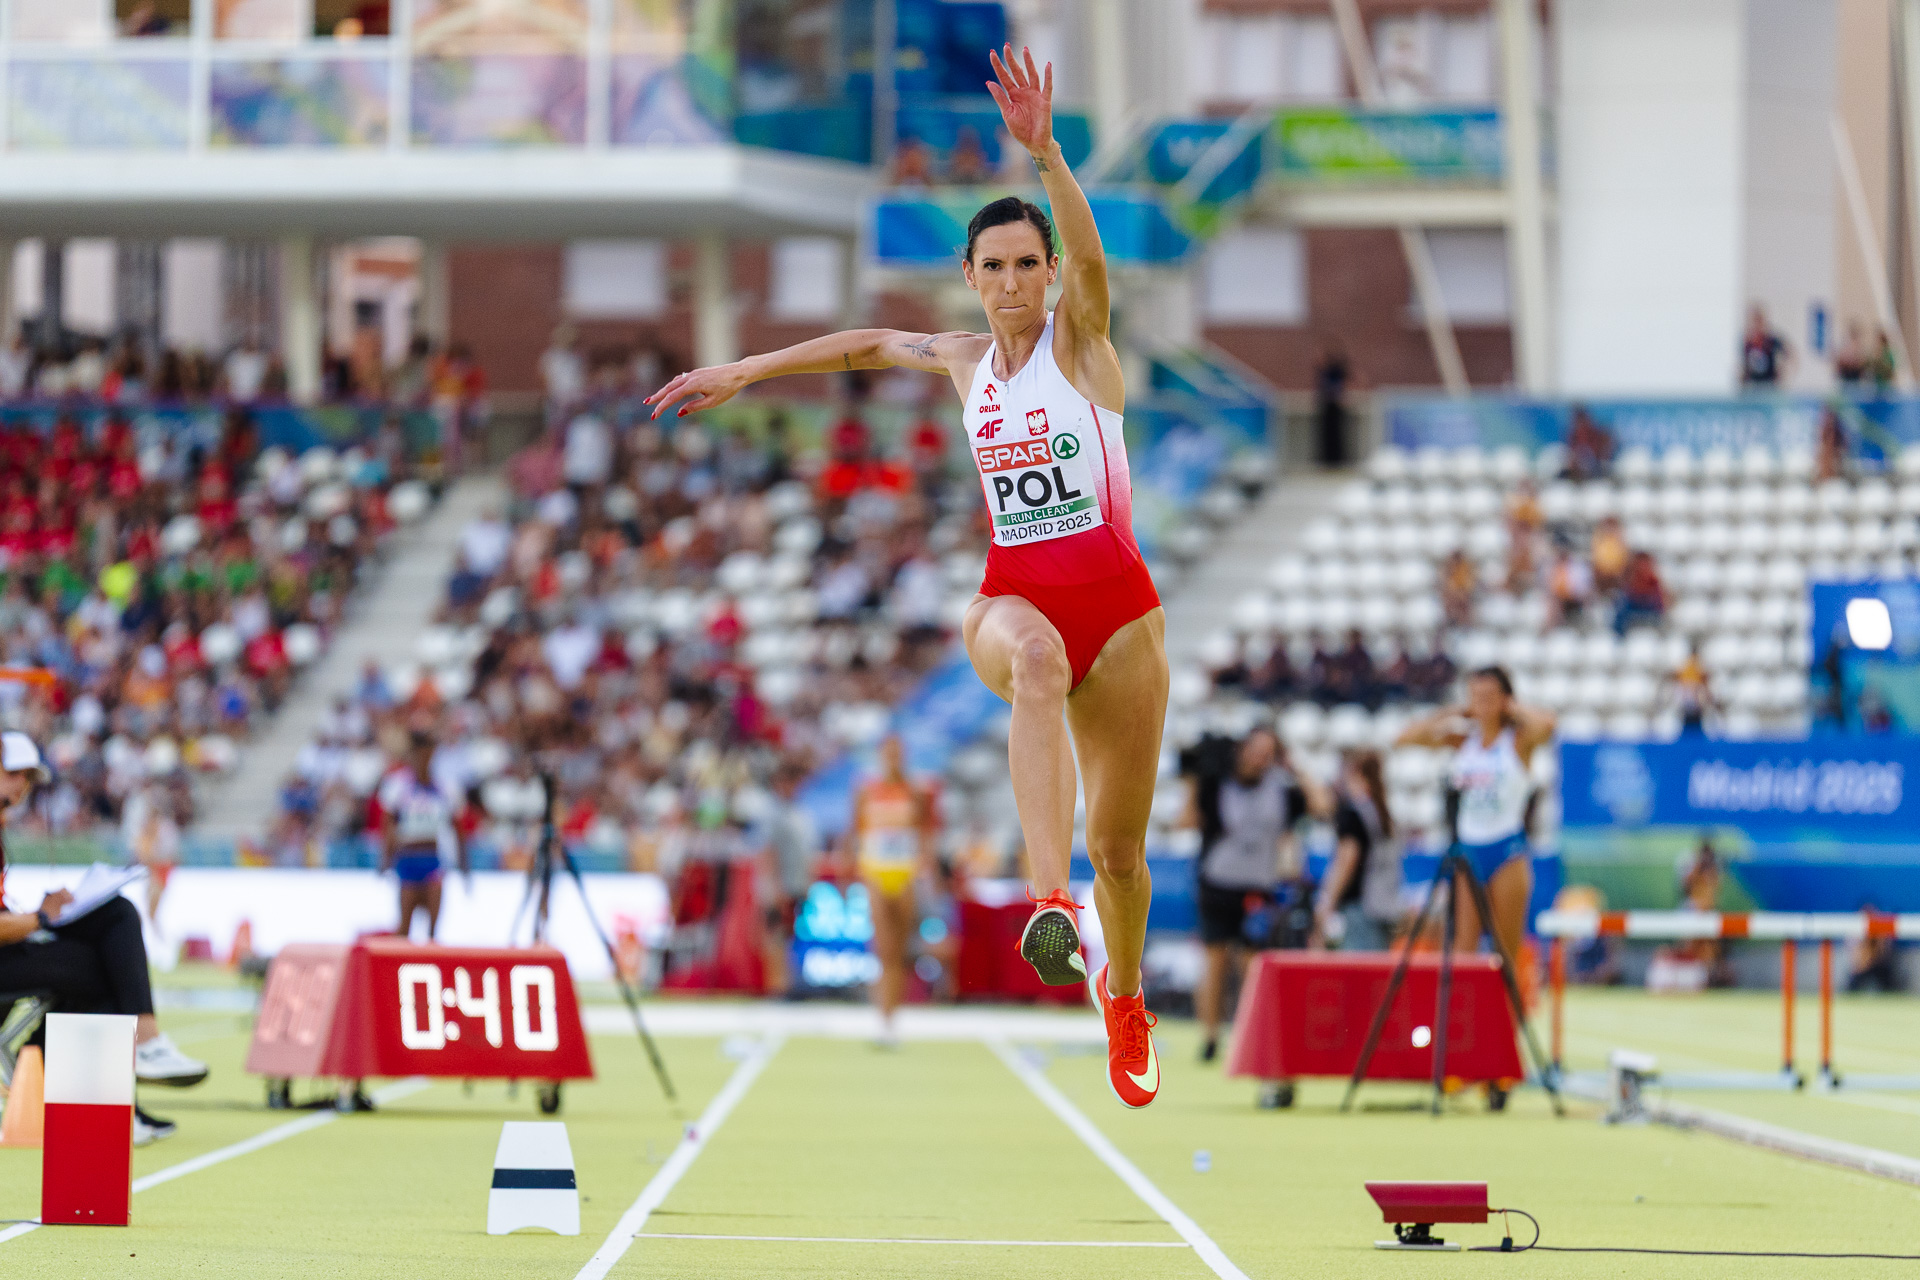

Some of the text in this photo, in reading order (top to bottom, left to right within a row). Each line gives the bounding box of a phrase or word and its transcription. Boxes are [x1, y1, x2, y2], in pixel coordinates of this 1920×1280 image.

[979, 404, 1000, 413] ORLEN
[976, 418, 1004, 440] 4F
[979, 442, 1049, 470] SPAR
[992, 465, 1081, 512] POL
[1001, 512, 1092, 542] MADRID 2025
[1011, 512, 1032, 523] RUN
[1689, 759, 1812, 813] Madrid
[398, 964, 559, 1051] 0:40
